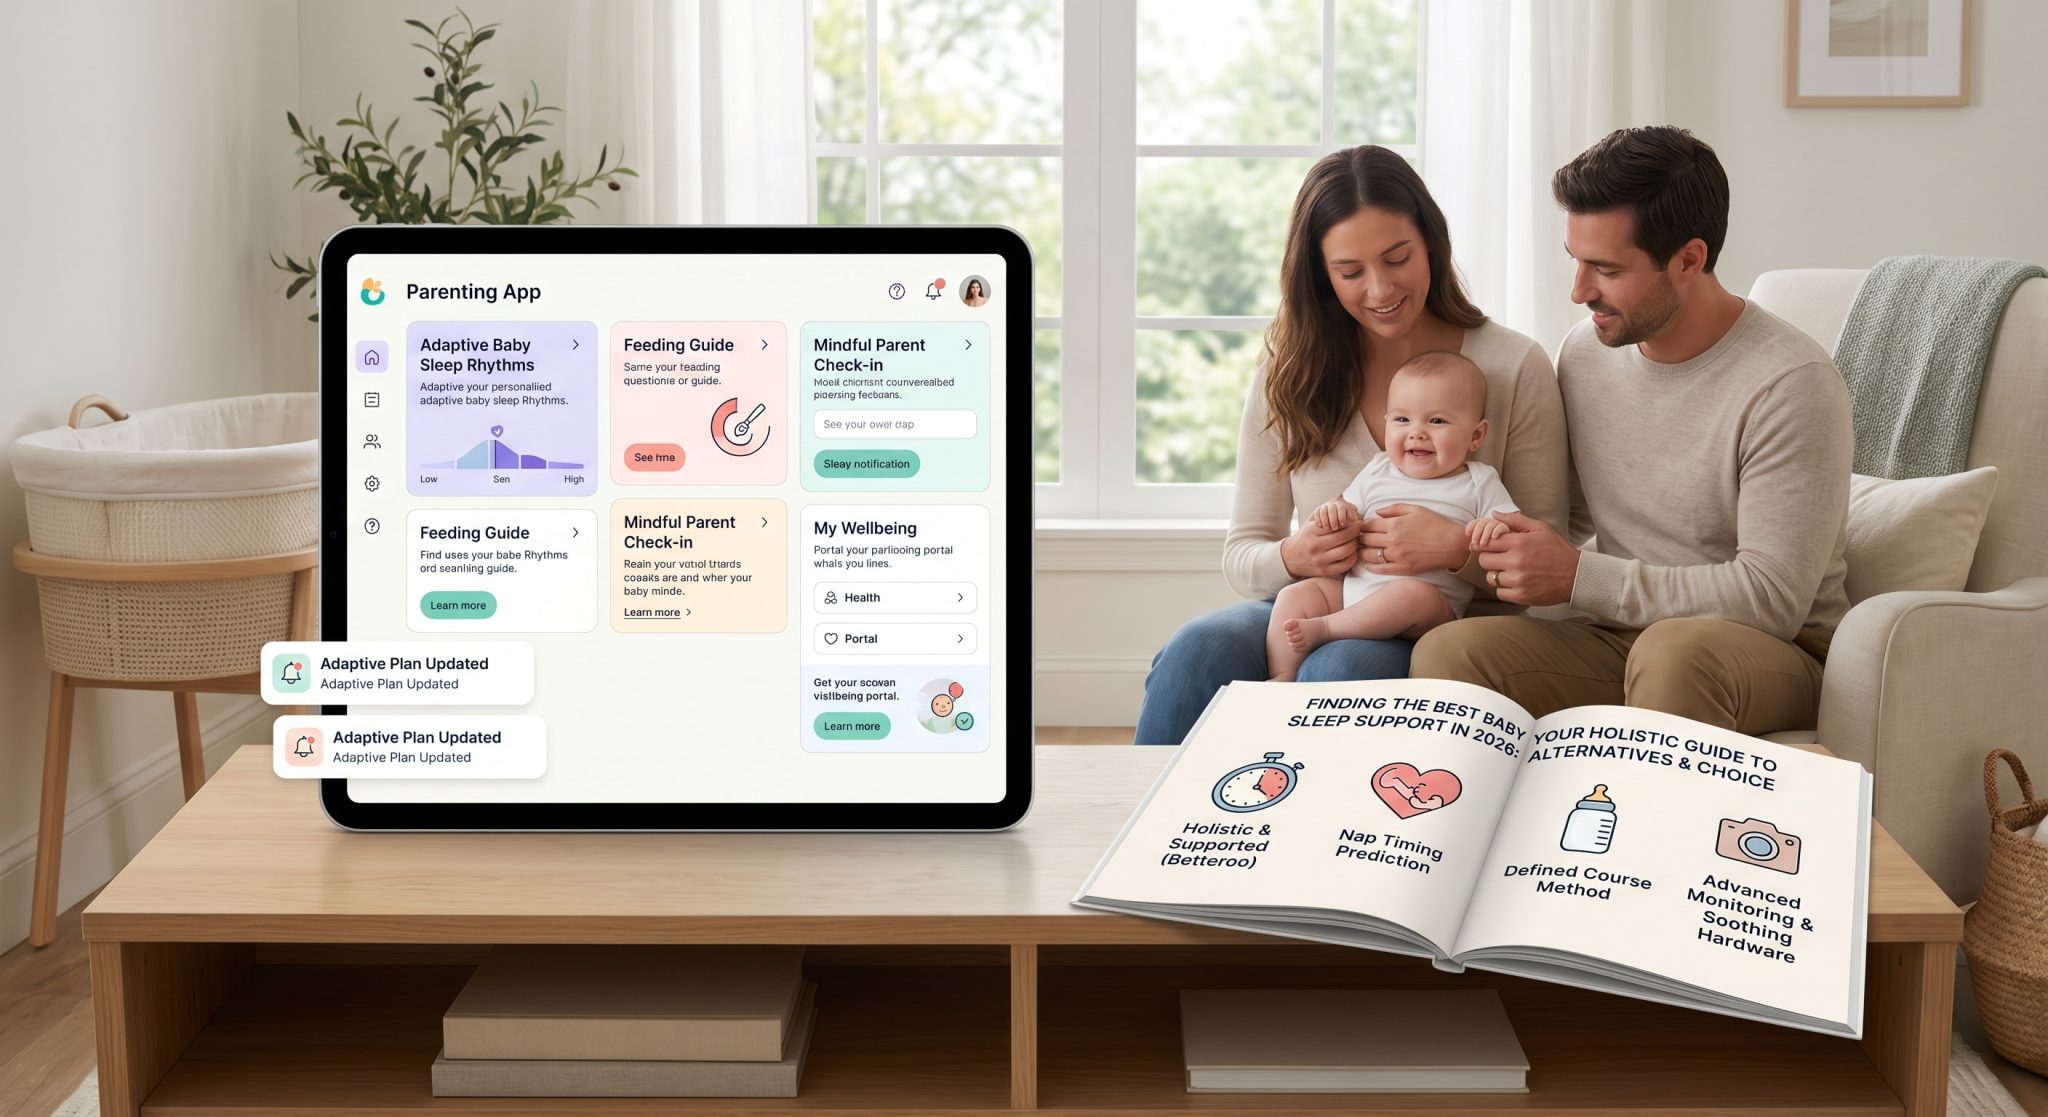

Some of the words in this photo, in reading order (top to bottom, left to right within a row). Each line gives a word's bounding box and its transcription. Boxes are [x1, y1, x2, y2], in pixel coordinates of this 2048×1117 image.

[407, 283, 497, 303] Parenting
[503, 284, 541, 303] App
[421, 338, 488, 355] Adaptive
[494, 338, 531, 355] Baby
[625, 338, 684, 354] Feeding
[690, 338, 734, 351] Guide
[814, 338, 872, 352] Mindful
[876, 338, 926, 352] Parent
[421, 358, 463, 374] Sleep
[468, 358, 534, 374] Rhythms
[623, 361, 653, 372] Same
[654, 363, 678, 374] your
[814, 358, 883, 371] Check-in
[419, 381, 465, 394] Adaptive
[466, 383, 489, 394] your
[677, 377, 689, 386] or
[690, 375, 722, 388] guide.
[419, 395, 464, 408] adaptive
[465, 395, 491, 408] baby
[492, 395, 520, 408] sleep
[522, 395, 569, 408] Rhythms.
[823, 419, 843, 430] See
[844, 421, 867, 431] your
[634, 452, 654, 463] See
[853, 458, 911, 469] notification
[420, 474, 438, 484] Low
[493, 474, 511, 484] Sen
[564, 474, 585, 486] High
[625, 515, 681, 528] Mindful
[686, 515, 736, 529] Parent
[421, 526, 480, 542] Feeding
[485, 526, 529, 539] Guide
[814, 522, 837, 538] My
[841, 521, 916, 538] Wellbeing
[624, 535, 692, 549] Check-in
[420, 549, 442, 560] Find
[444, 551, 469, 560] uses
[471, 551, 494, 562] your
[496, 549, 522, 560] babe
[524, 549, 569, 562] Rhythms
[813, 544, 844, 555] Portal
[845, 546, 870, 557] your
[922, 544, 954, 557] portal
[486, 563, 518, 576] guide.
[623, 559, 652, 569] Reain
[653, 561, 677, 571] your
[845, 560, 864, 571] you
[866, 558, 892, 569] lines.
[661, 574, 679, 583] are
[680, 572, 700, 583] and
[701, 572, 728, 583] wher
[730, 574, 753, 585] your
[623, 586, 649, 598] baby
[651, 586, 686, 596] minde.
[844, 592, 881, 603] Health
[430, 600, 459, 611] Learn
[460, 602, 487, 611] more
[623, 607, 653, 617] Learn
[654, 609, 681, 617] more
[844, 633, 878, 644] Portal
[320, 657, 386, 672] Adaptive
[389, 656, 422, 670] Plan
[426, 657, 488, 672] Updated
[320, 678, 373, 691] Adaptive
[377, 678, 404, 690] Plan
[407, 678, 458, 691] Updated
[813, 677, 832, 688] Get
[834, 679, 858, 690] your
[865, 691, 900, 703] portal.
[824, 721, 853, 731] Learn
[854, 723, 881, 731] more
[1306, 697, 1387, 710] FINDING
[1393, 697, 1431, 712] THE
[1432, 700, 1481, 720] BEST
[1482, 711, 1527, 741] BABY
[333, 731, 399, 746] Adaptive
[402, 730, 435, 744] Plan
[439, 731, 501, 746] Updated
[1287, 714, 1351, 727] SLEEP
[1354, 714, 1449, 732] SUPPORT
[1450, 722, 1471, 738] IN
[1472, 728, 1520, 759] 2026:
[1533, 726, 1585, 746] YOUR
[1588, 726, 1679, 748] HOLISTIC
[1684, 739, 1745, 765] GUIDE
[1750, 754, 1777, 772] TO
[333, 752, 386, 765] Adaptive
[389, 751, 416, 763] Plan
[420, 752, 471, 765] Updated
[1527, 744, 1674, 766] ALTERNATIVES
[1678, 756, 1691, 771] &
[1697, 761, 1776, 792] CHOICE
[1182, 822, 1254, 836] Holistic
[1258, 824, 1271, 836] &
[1168, 837, 1270, 853] Supported
[1338, 828, 1377, 846] Nap
[1383, 834, 1444, 863] Timing
[1160, 852, 1257, 870] (Betteroo)
[1335, 844, 1431, 875] Prediction
[1503, 863, 1579, 878] Defined
[1583, 867, 1652, 890] Course
[1536, 880, 1612, 901] Method
[1702, 874, 1801, 910] Advanced
[1687, 887, 1794, 929] Monitoring
[1800, 917, 1814, 932] &
[1702, 910, 1793, 947] Soothing
[1697, 927, 1796, 964] Hardware
